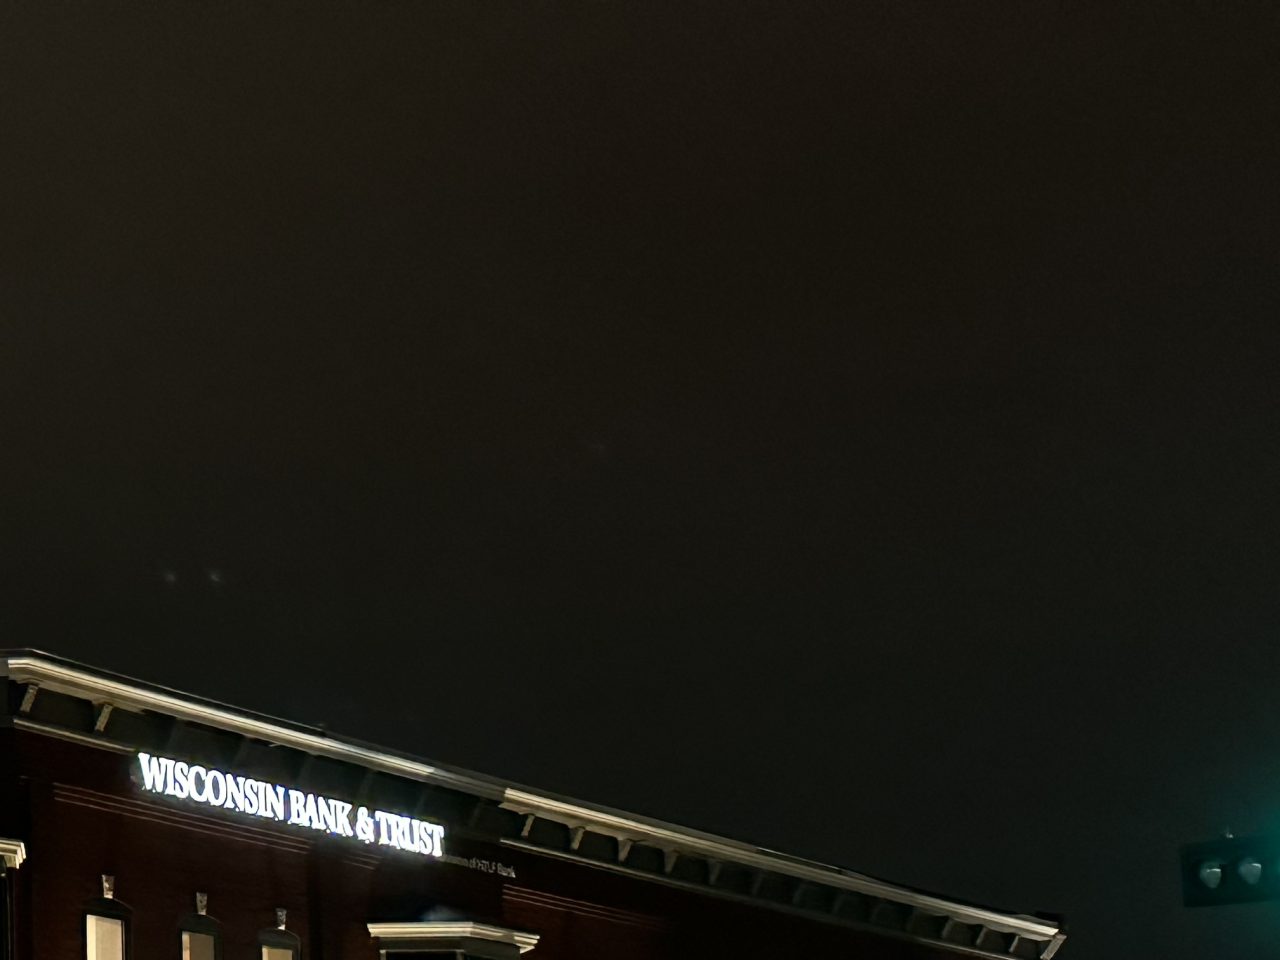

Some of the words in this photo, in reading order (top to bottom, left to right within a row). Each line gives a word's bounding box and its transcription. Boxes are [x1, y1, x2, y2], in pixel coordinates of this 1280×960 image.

[137, 752, 285, 822] WISCONSIN
[288, 789, 355, 838] BANK
[355, 806, 375, 844] &
[375, 810, 445, 858] TRUST
